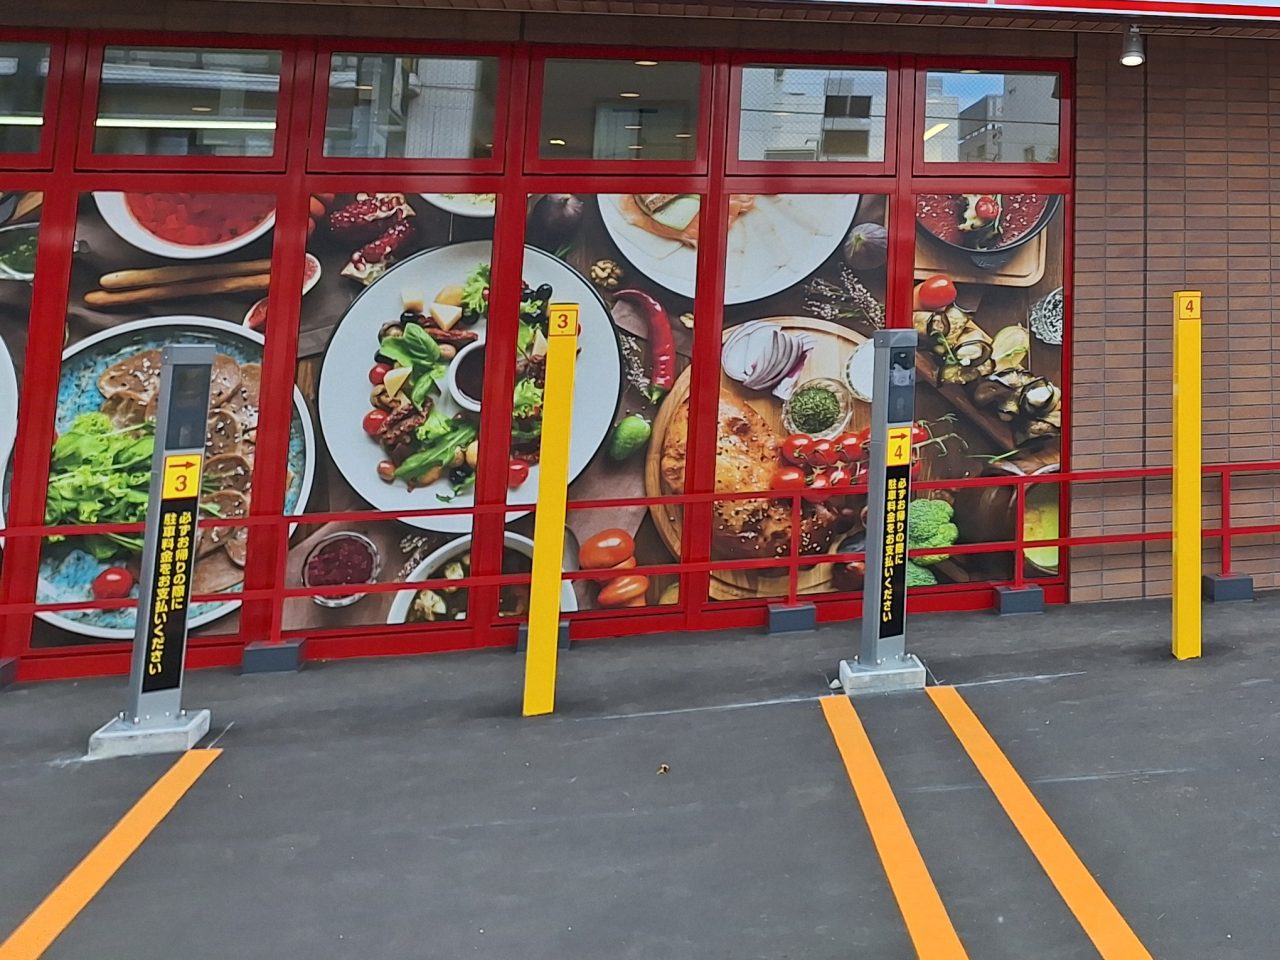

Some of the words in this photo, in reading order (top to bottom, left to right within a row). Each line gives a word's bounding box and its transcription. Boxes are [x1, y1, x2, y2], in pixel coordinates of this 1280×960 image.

[1185, 299, 1195, 313] 4
[557, 313, 569, 329] 3
[893, 443, 903, 460] 4
[174, 474, 188, 492] 3
[171, 511, 192, 610] 必ずお帰りの際に
[149, 512, 177, 676] 駐車料金をお支払いください
